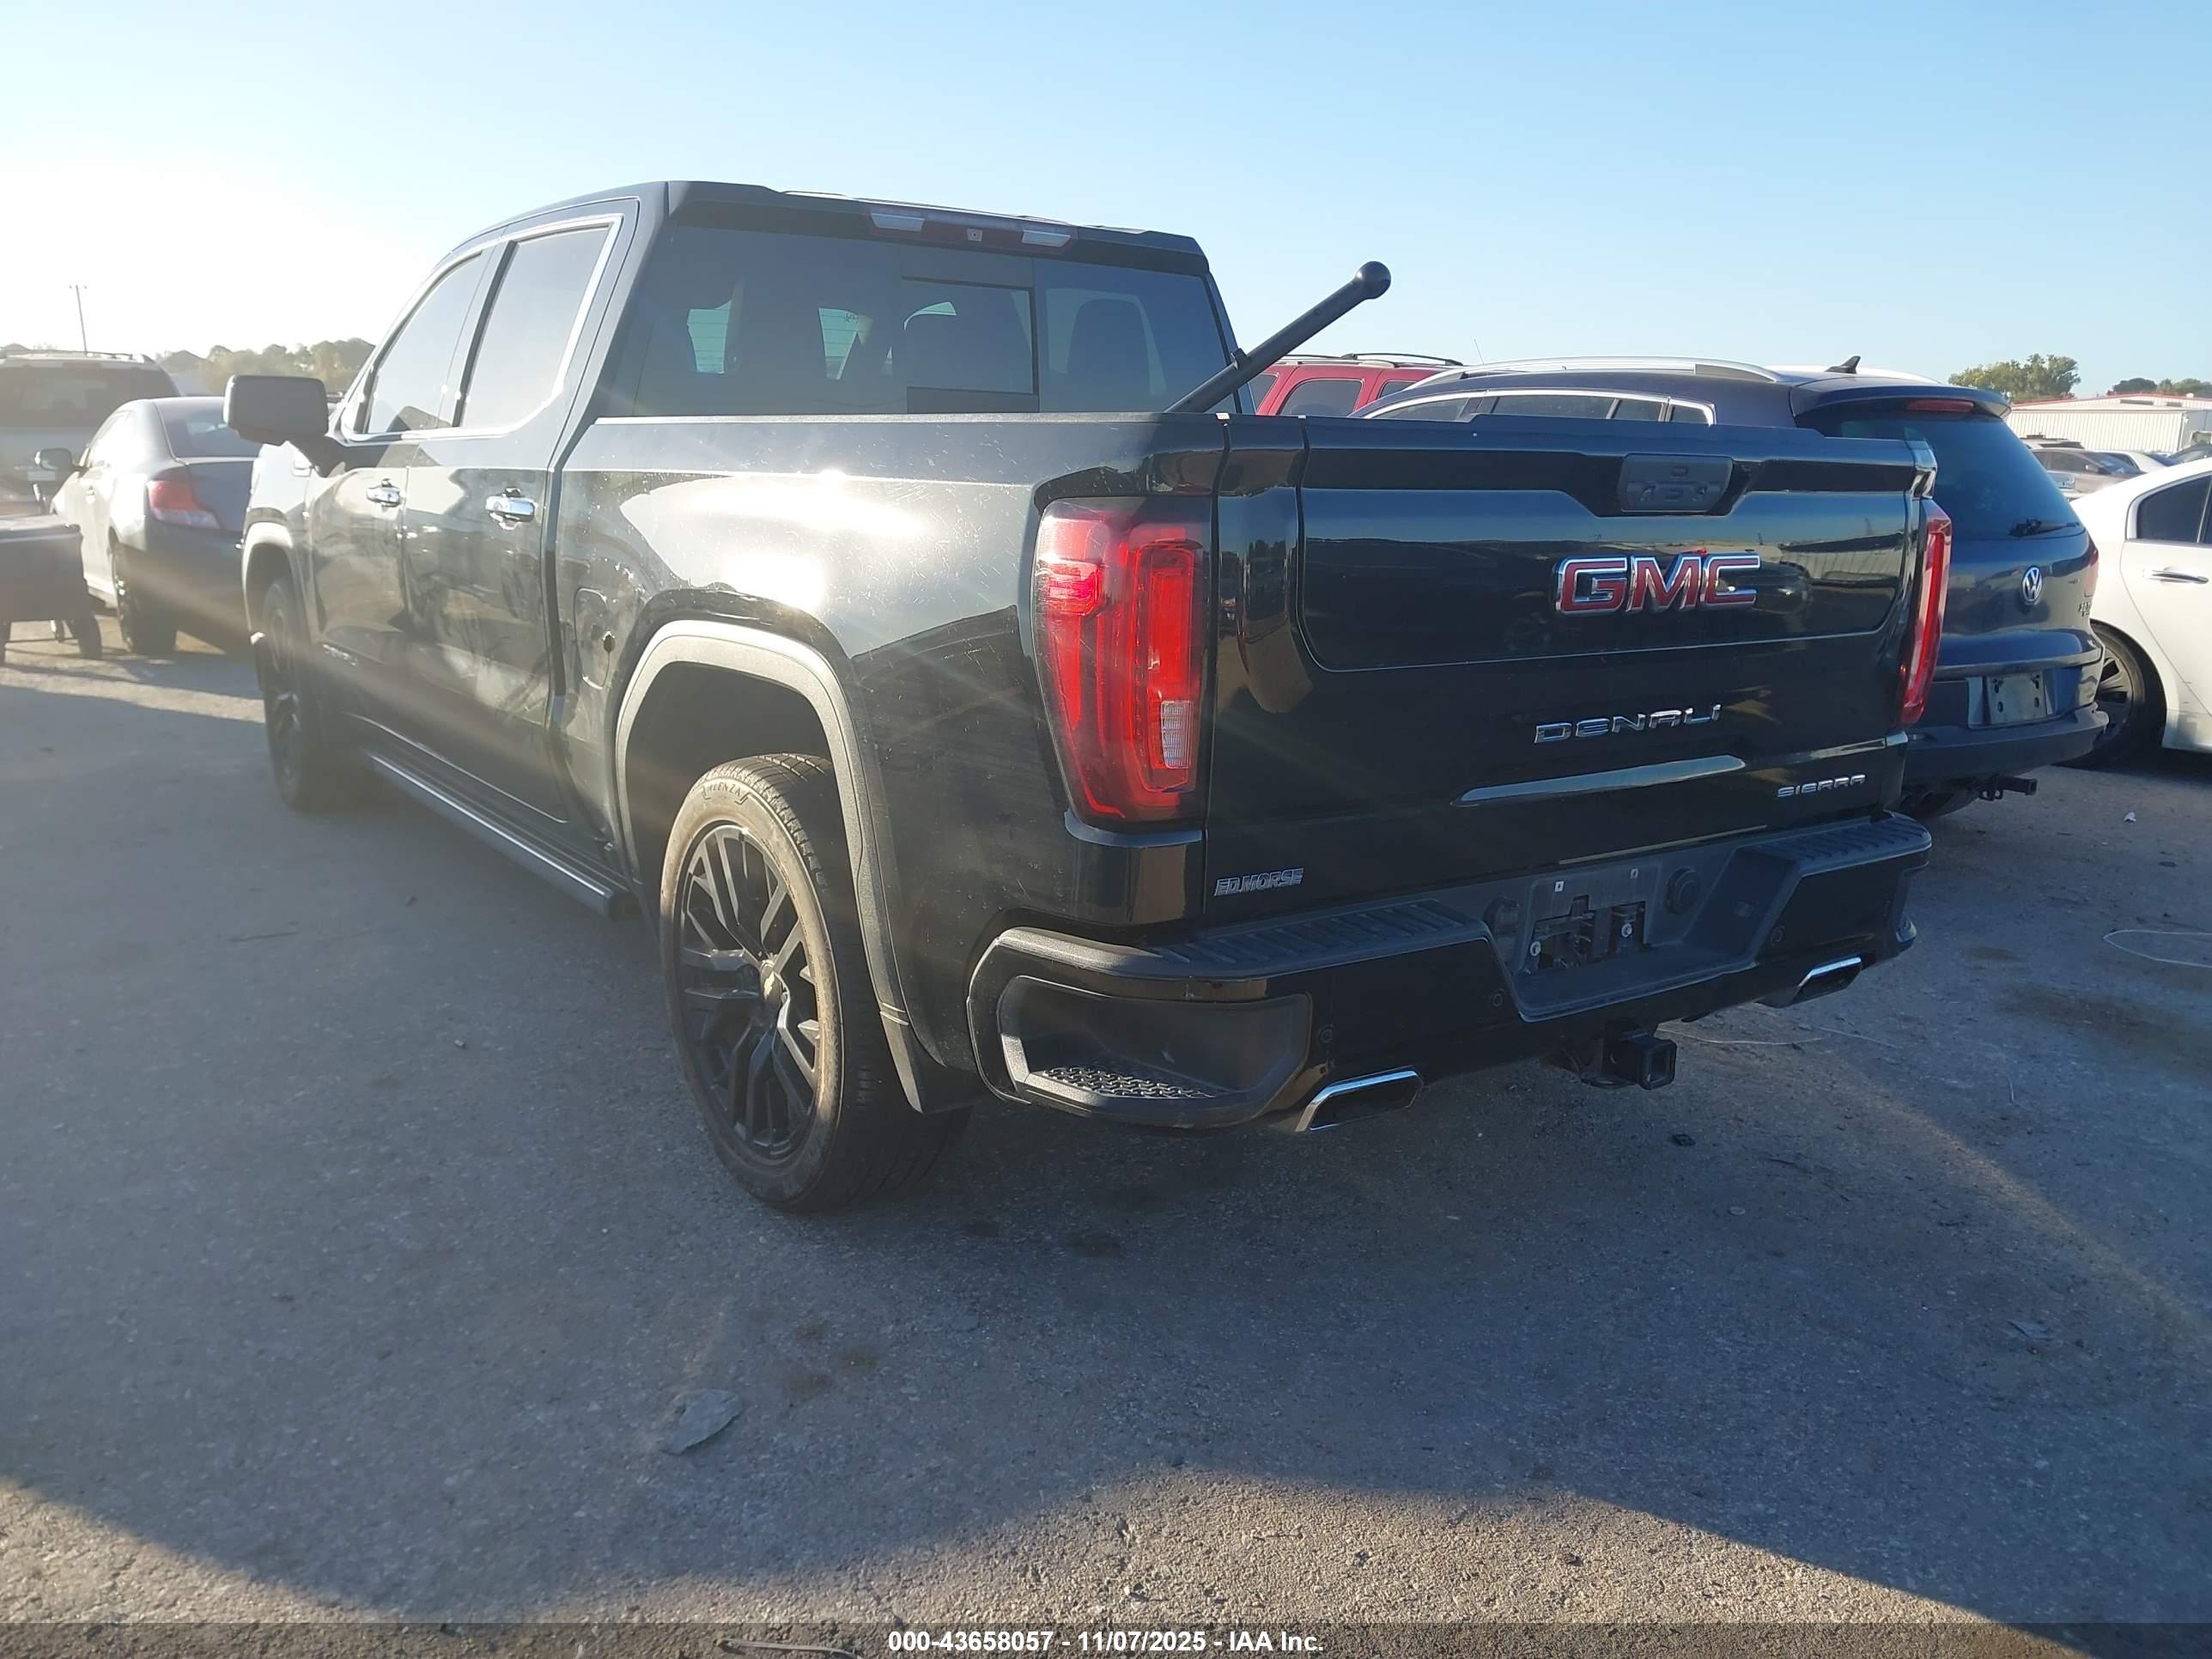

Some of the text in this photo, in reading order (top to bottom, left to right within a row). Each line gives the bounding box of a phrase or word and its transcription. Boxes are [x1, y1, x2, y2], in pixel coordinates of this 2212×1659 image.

[1555, 552, 1760, 615] GMC
[1534, 703, 1721, 744] DENALI
[1778, 774, 1866, 797] SIERRA
[1240, 867, 1304, 893] MORSE
